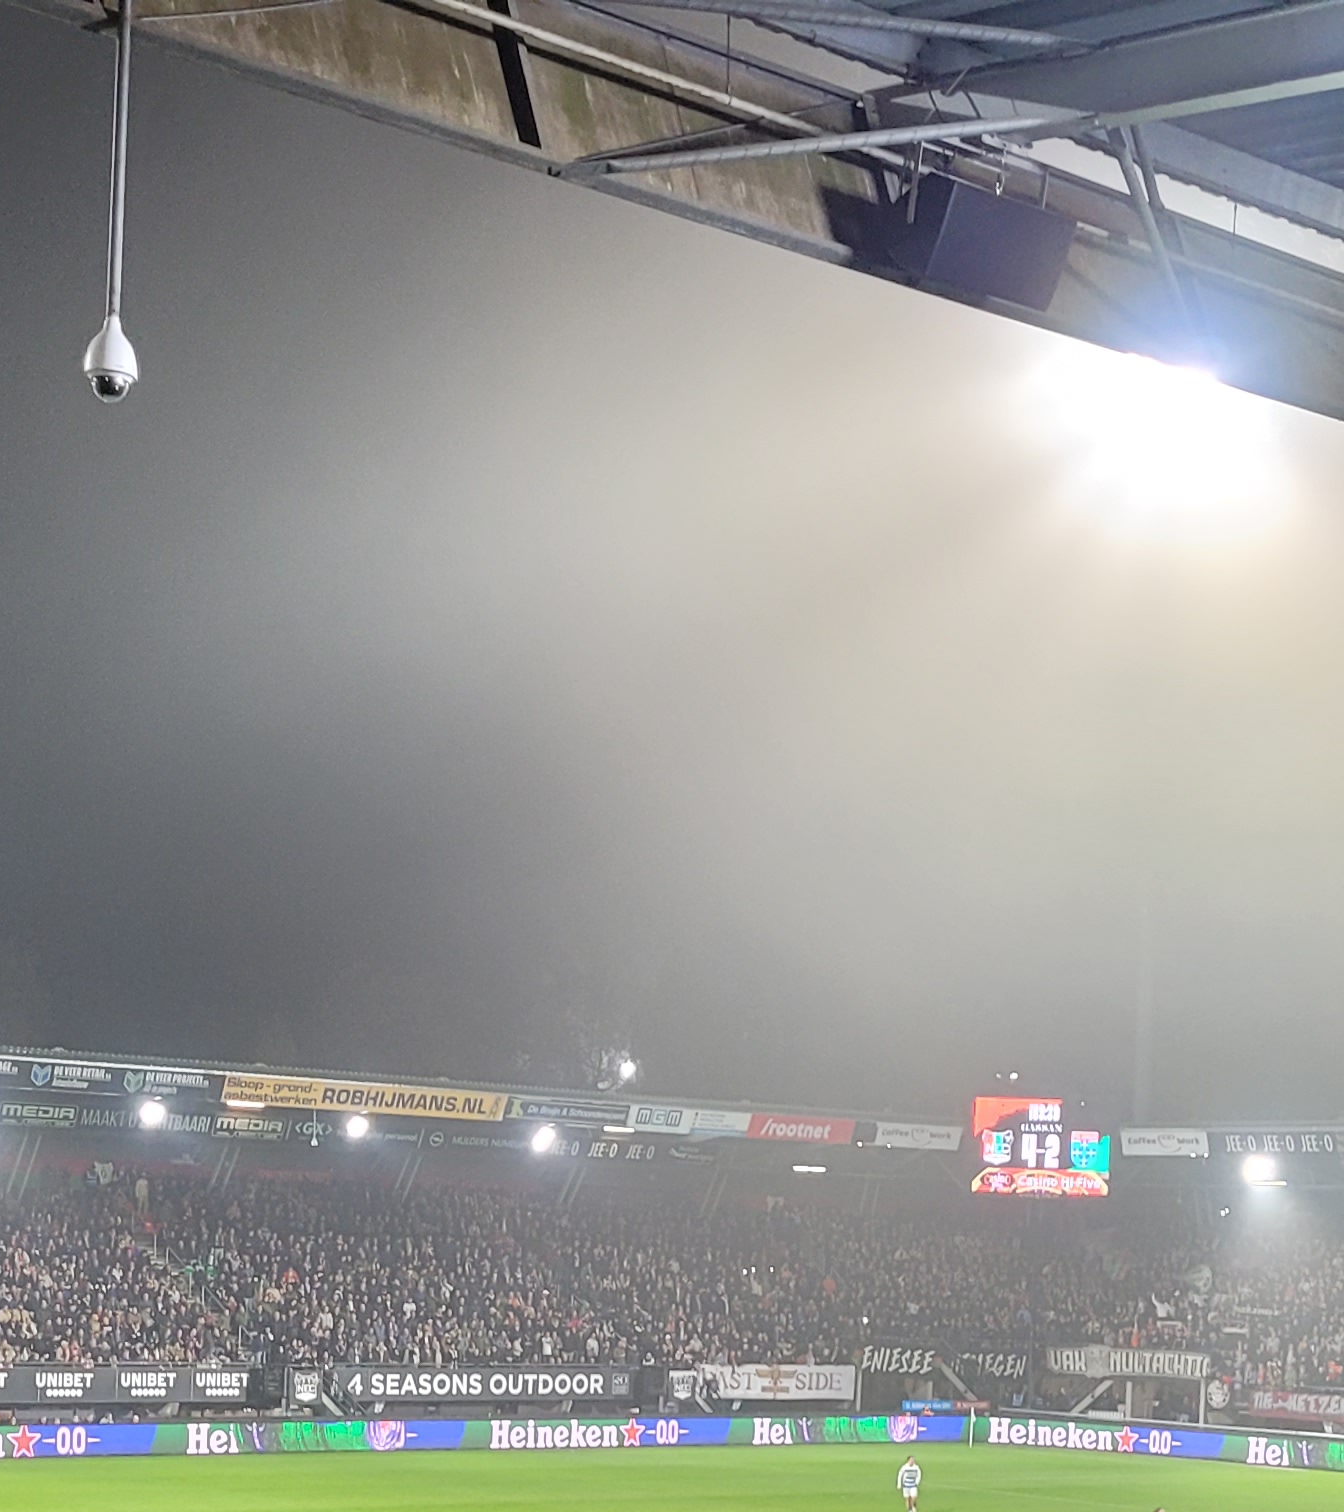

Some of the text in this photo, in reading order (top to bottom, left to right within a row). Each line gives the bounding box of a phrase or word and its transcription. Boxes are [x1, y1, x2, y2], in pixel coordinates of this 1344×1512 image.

[321, 1088, 487, 1115] ROBHIJMANS.NL
[2, 1104, 77, 1119] MEDIA
[216, 1118, 283, 1133] MEDIA
[636, 1107, 683, 1127] MGM
[36, 1372, 95, 1388] UNIBET
[121, 1372, 176, 1388] UNIBET
[196, 1372, 250, 1388] UNIBET
[346, 1374, 363, 1396] 4
[370, 1373, 483, 1396] SEASONS
[489, 1373, 604, 1396] OUTDOOR
[795, 1372, 843, 1391] SIDE
[490, 1419, 619, 1450] Heineken
[988, 1416, 1114, 1452] Heineken
